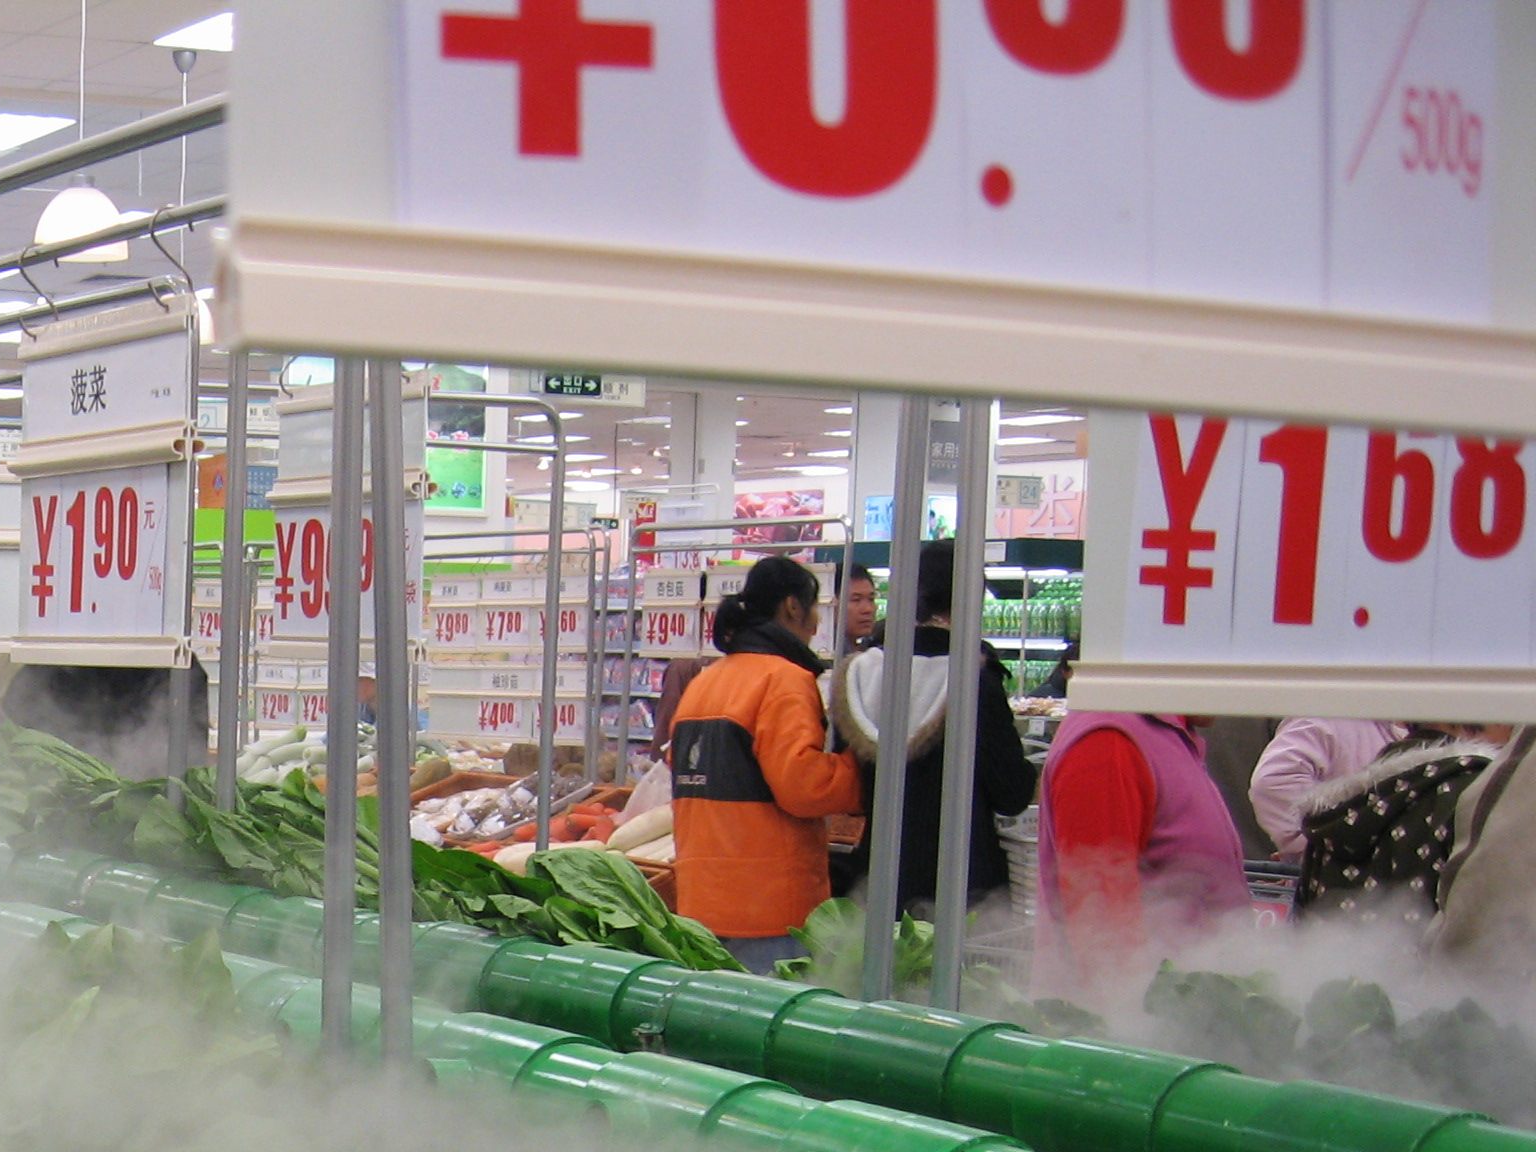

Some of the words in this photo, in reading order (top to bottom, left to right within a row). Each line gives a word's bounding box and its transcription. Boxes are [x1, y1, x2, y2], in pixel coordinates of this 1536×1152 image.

[70, 365, 107, 415] 菠菜
[562, 386, 582, 394] EXIT
[31, 486, 139, 618] ¥1.90
[1139, 411, 1527, 629] ¥1.68
